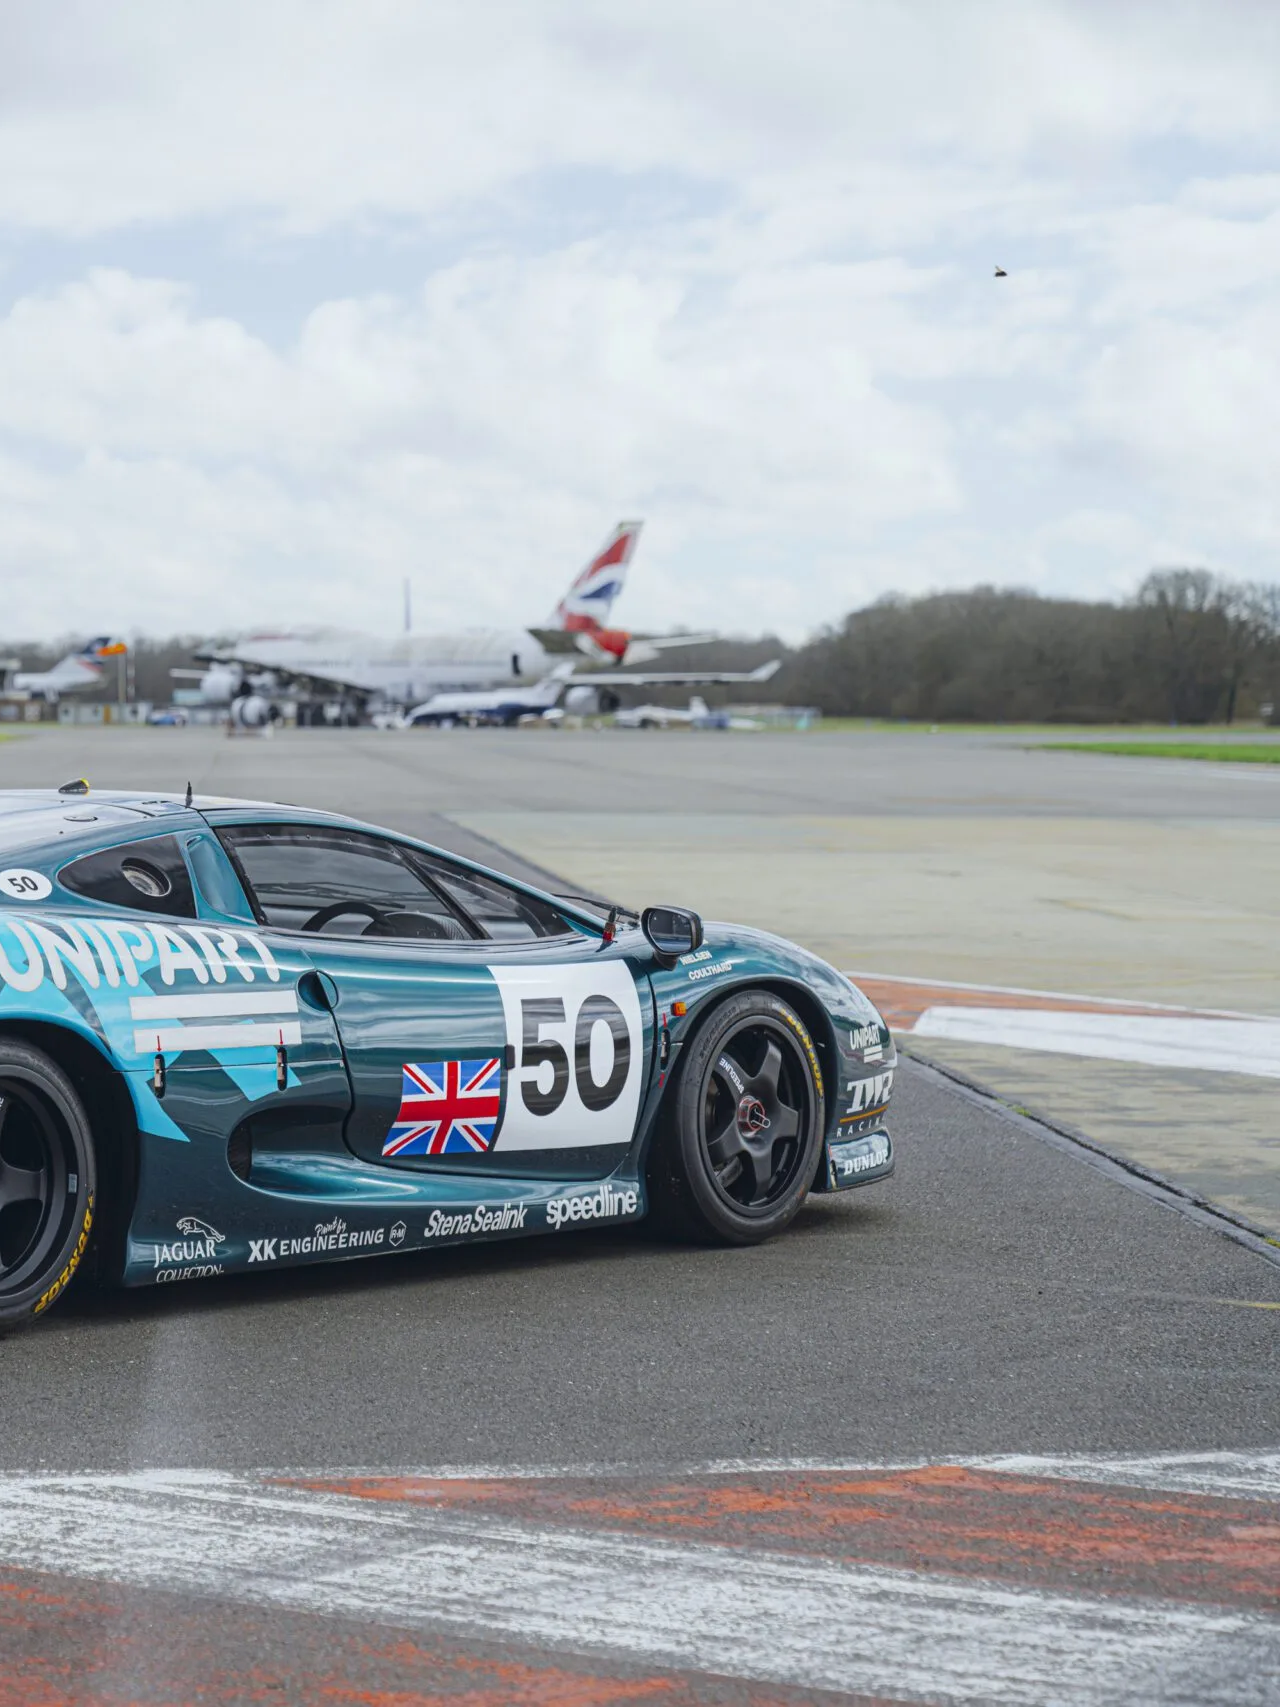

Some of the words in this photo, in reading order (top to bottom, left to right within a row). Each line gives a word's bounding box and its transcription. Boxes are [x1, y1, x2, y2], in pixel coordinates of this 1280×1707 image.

[7, 876, 38, 893] 50
[688, 962, 732, 980] COULTHARD
[849, 1024, 881, 1050] UNIPART
[520, 994, 631, 1117] 50
[846, 1069, 894, 1114] TWR
[844, 1150, 888, 1176] DUNLOP
[546, 1184, 637, 1230] speedline
[34, 1207, 93, 1314] DUNLOP
[154, 1240, 216, 1268] JAGUAR
[248, 1238, 278, 1263] XK
[280, 1228, 385, 1256] ENGINEERING
